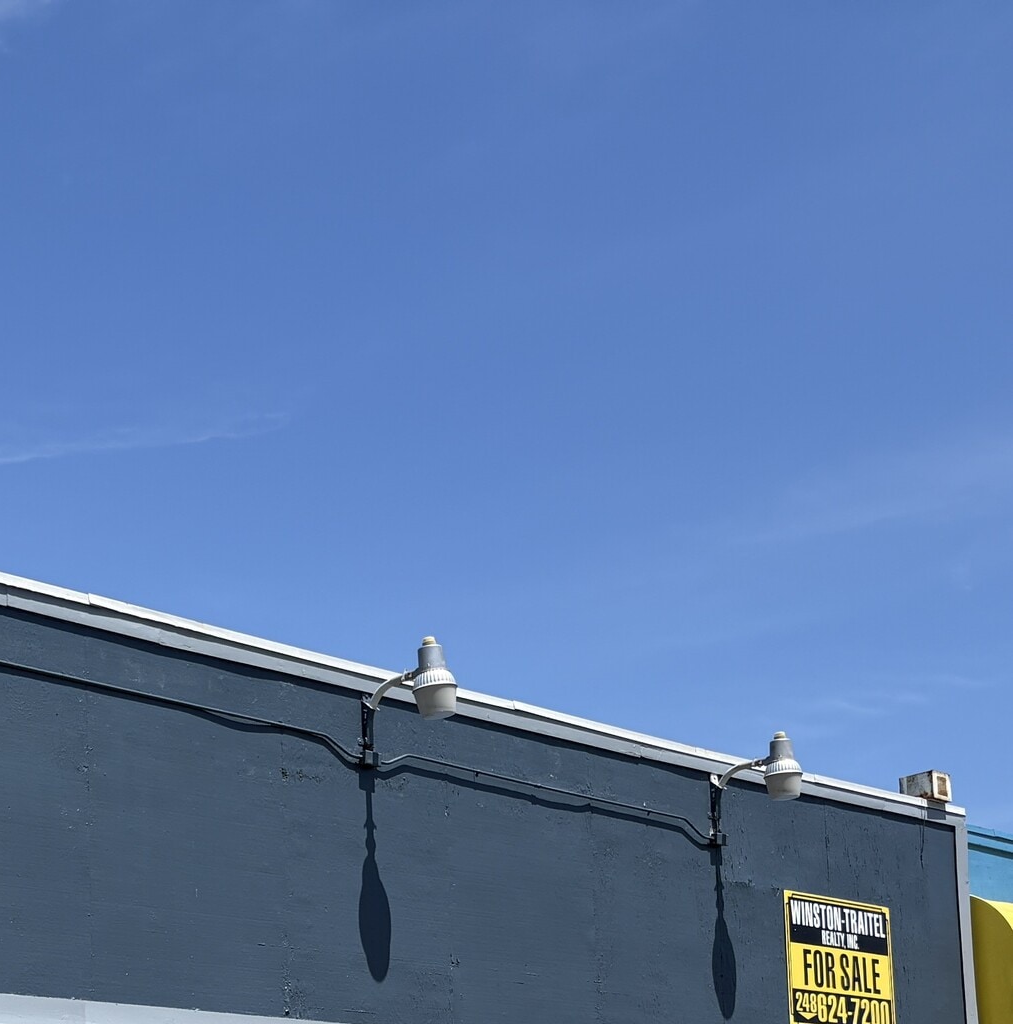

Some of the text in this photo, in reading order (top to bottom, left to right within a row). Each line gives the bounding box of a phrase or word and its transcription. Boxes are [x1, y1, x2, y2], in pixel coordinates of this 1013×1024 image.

[790, 899, 886, 938] WINSTON-TRAITEL
[803, 949, 881, 995] FOR SALE
